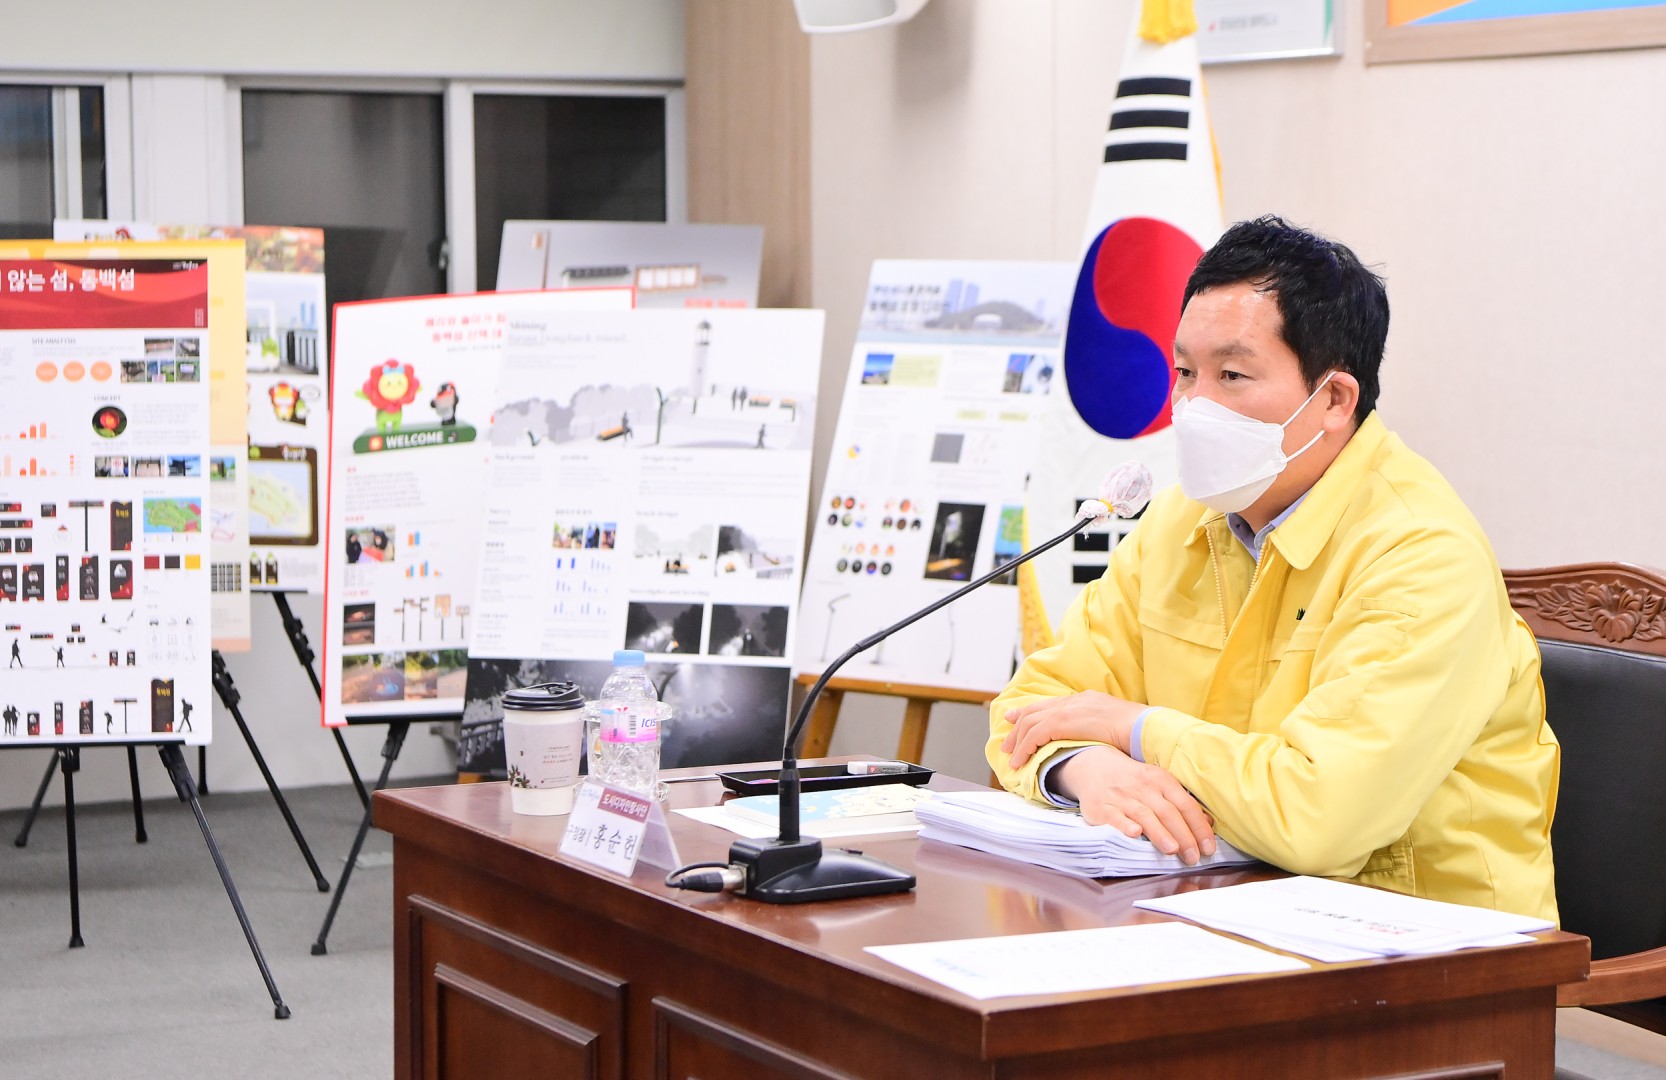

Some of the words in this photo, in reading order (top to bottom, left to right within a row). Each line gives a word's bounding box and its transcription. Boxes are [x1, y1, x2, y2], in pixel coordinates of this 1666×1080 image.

[7, 269, 45, 292] 않는
[50, 269, 74, 292] 섬,
[79, 268, 135, 291] 동백섬
[386, 432, 444, 449] WELCOME
[593, 824, 638, 860] 홍순헌
